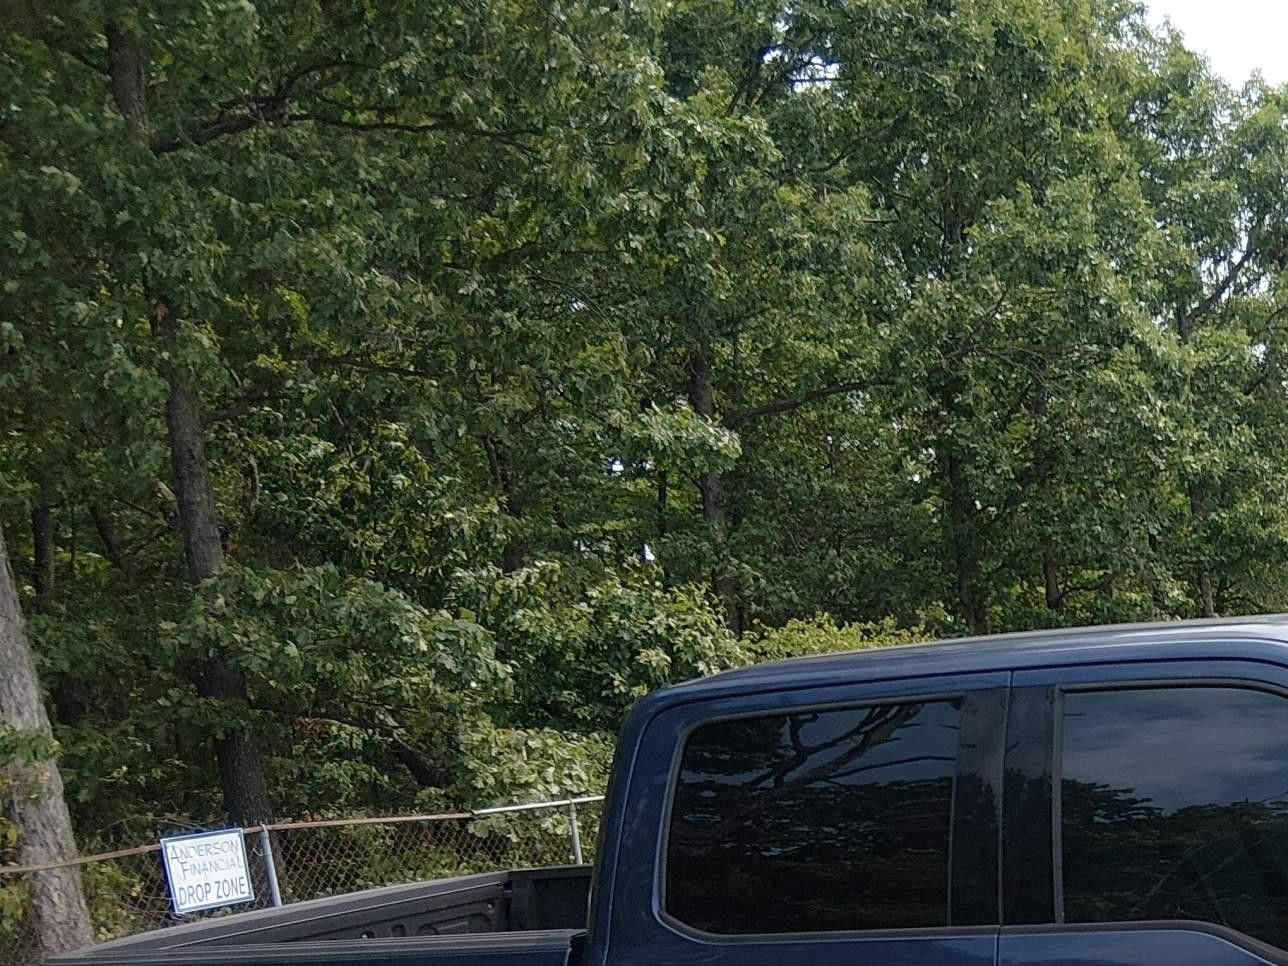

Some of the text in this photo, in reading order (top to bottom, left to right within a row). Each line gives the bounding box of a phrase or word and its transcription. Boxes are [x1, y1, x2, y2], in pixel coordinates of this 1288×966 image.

[170, 839, 239, 863] ANDERSON
[180, 856, 244, 880] FINANCIAL
[178, 876, 246, 905] DROP ZONE
